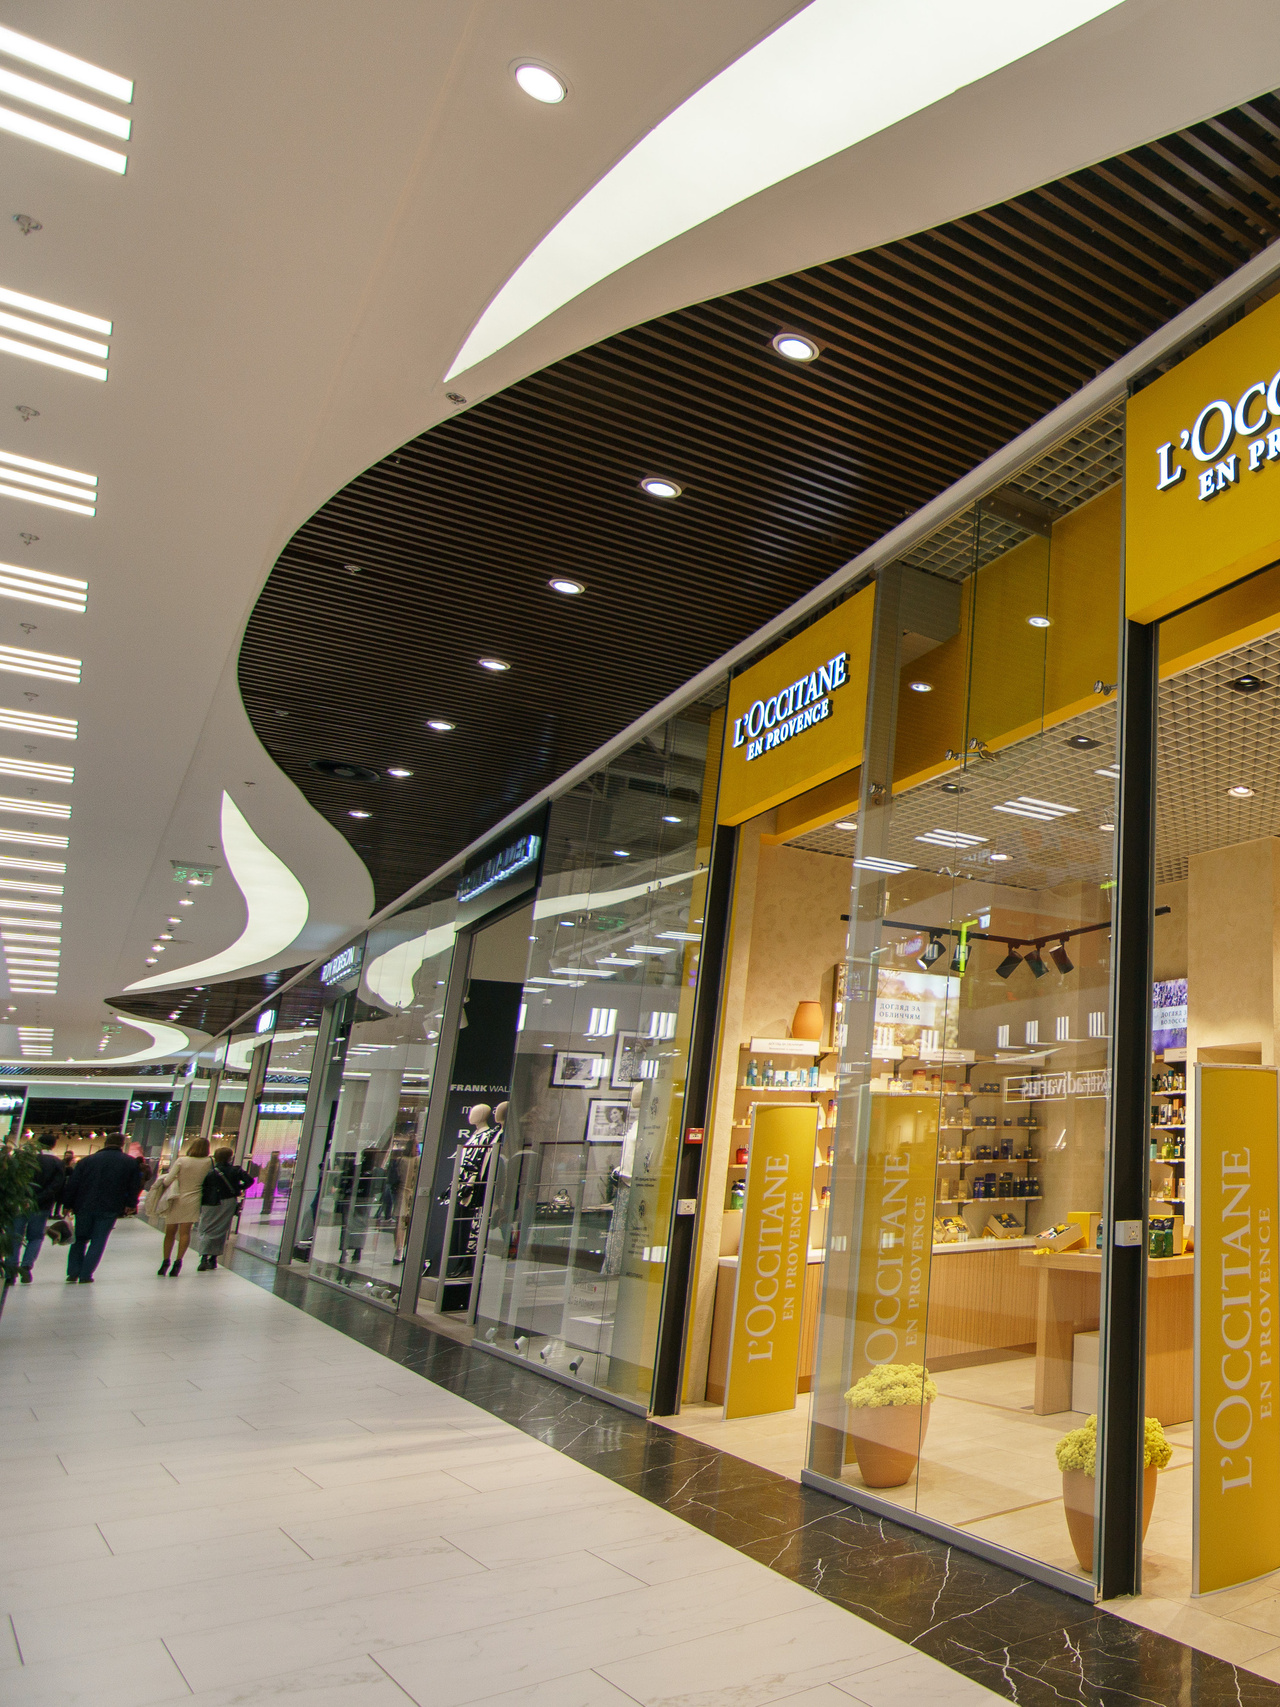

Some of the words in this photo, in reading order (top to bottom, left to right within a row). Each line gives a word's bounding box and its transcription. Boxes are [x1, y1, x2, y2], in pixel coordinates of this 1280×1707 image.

[1198, 454, 1238, 501] EN
[732, 651, 848, 748] L'OCCITANE
[746, 737, 765, 761] EN
[765, 697, 831, 751] PROVENCE
[879, 1002, 910, 1012] ДОГЛЯД
[879, 1011, 921, 1020] ОБЛИЧЧЯМ
[1160, 1017, 1187, 1026] ВОЛОССЯ
[449, 1083, 488, 1092] FRANK
[490, 1084, 511, 1093] WAL
[745, 1154, 790, 1362] L'OCCITANE
[785, 1191, 804, 1288] PROVENCE
[864, 1152, 911, 1365] OCCITANE
[907, 1196, 926, 1309] PROVENCE
[782, 1297, 795, 1320] EN
[1258, 1207, 1271, 1365] PROVENCE
[905, 1319, 918, 1346] EN
[1213, 1147, 1252, 1495] L'OCCITANE
[1260, 1380, 1272, 1418] EN
